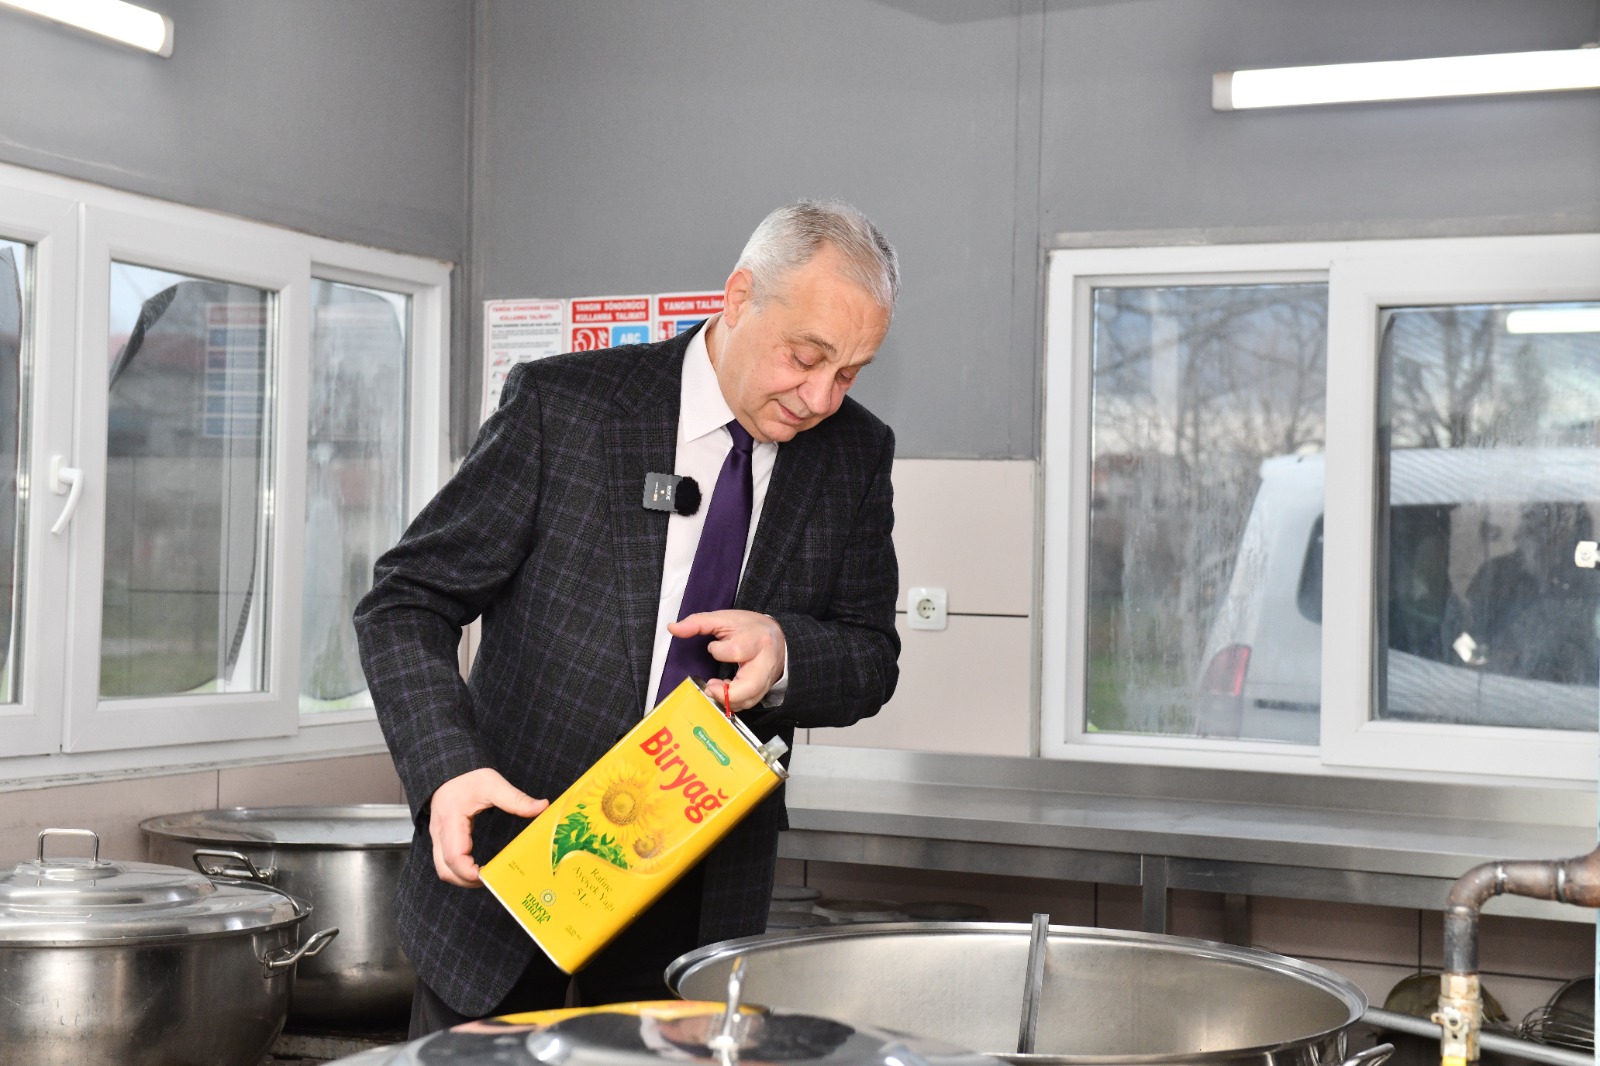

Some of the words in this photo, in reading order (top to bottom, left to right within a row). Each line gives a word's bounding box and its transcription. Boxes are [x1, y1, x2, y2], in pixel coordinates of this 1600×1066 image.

[575, 303, 602, 311] YANGIN
[663, 301, 694, 311] YANGIN
[696, 299, 724, 310] TALİMA
[620, 333, 642, 344] ABC
[640, 726, 729, 824] Biryağ
[525, 891, 551, 922] TRAKYA
